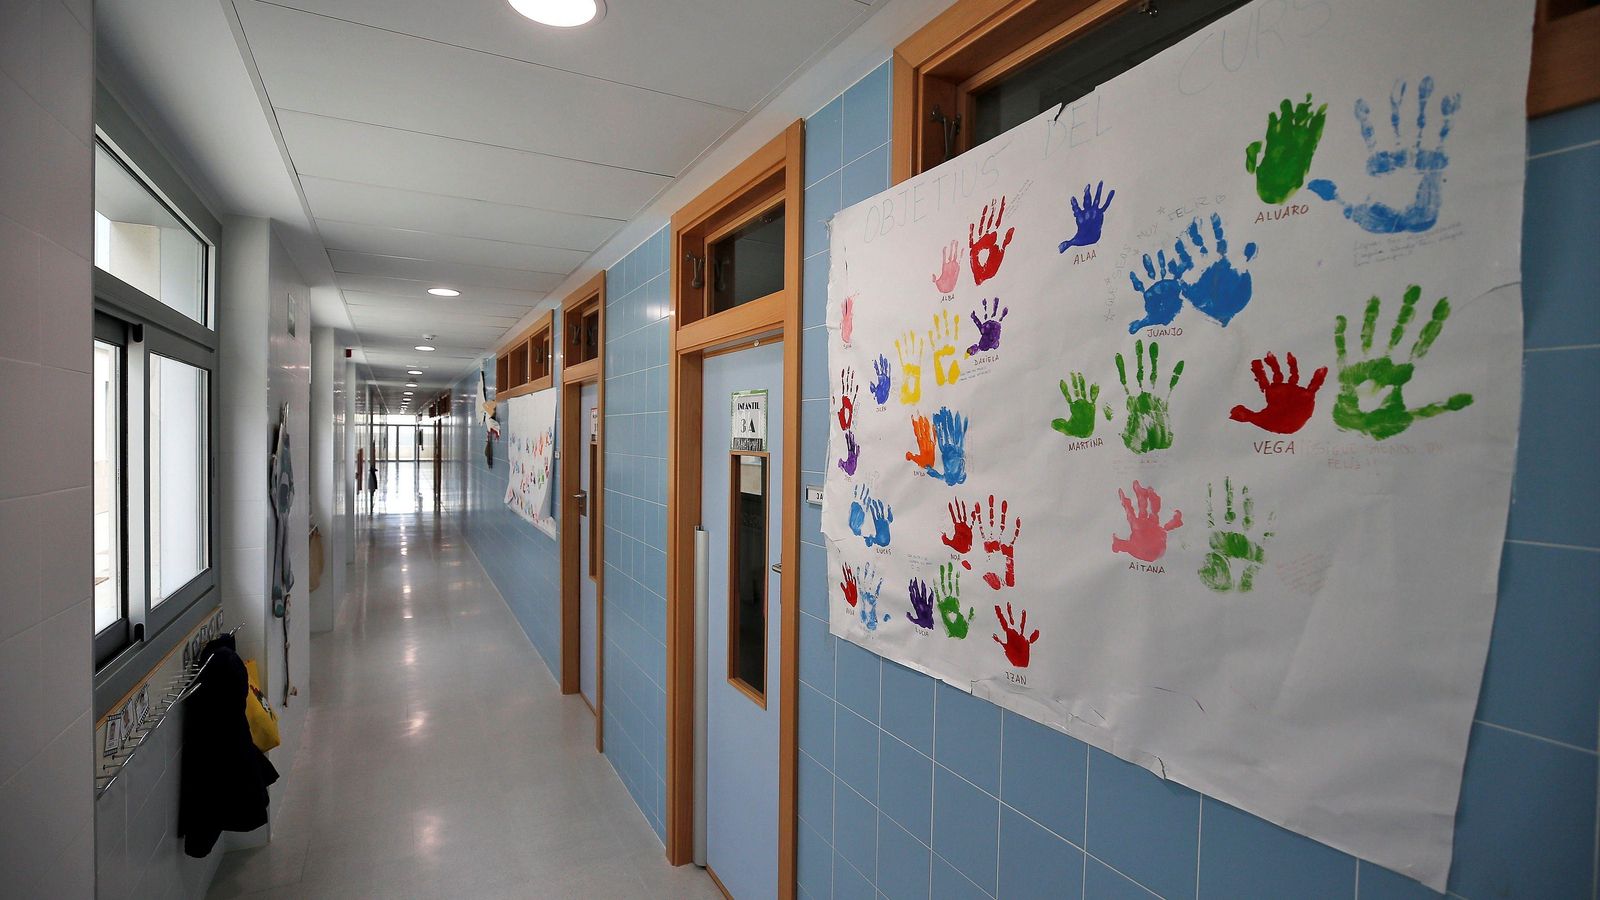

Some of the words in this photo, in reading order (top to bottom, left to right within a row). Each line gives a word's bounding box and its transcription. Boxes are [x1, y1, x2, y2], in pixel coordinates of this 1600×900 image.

[1044, 95, 1112, 160] DEL
[1254, 203, 1310, 224] ALVARO
[1073, 249, 1097, 265] ALAA
[940, 293, 955, 304] ALBA
[1146, 327, 1183, 338] JUANJO
[737, 401, 760, 411] INFANTIL
[1253, 440, 1296, 455] VEGA
[1005, 671, 1028, 686] IZAN
